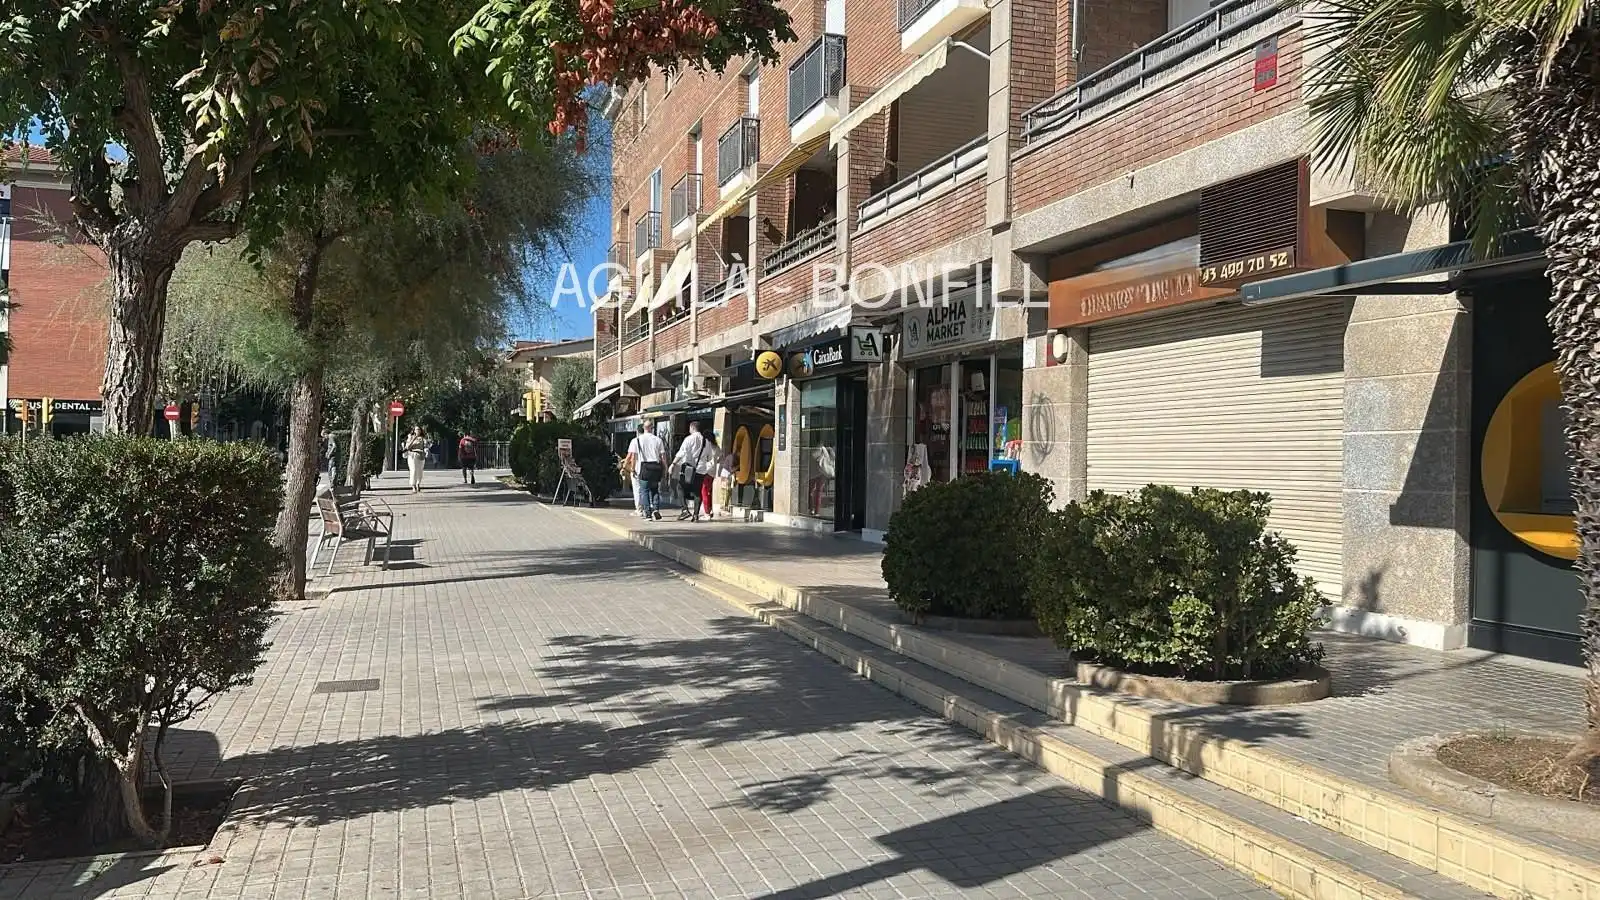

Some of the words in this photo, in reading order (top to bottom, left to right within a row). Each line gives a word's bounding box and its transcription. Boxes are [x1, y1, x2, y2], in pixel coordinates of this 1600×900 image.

[1220, 260, 1244, 279] 499
[1247, 256, 1265, 273] 70
[1269, 251, 1288, 269] 52
[926, 299, 967, 328] ALPHA
[926, 320, 966, 343] MARKET
[813, 344, 843, 365] CaixaBank
[54, 402, 91, 411] DENTAL
